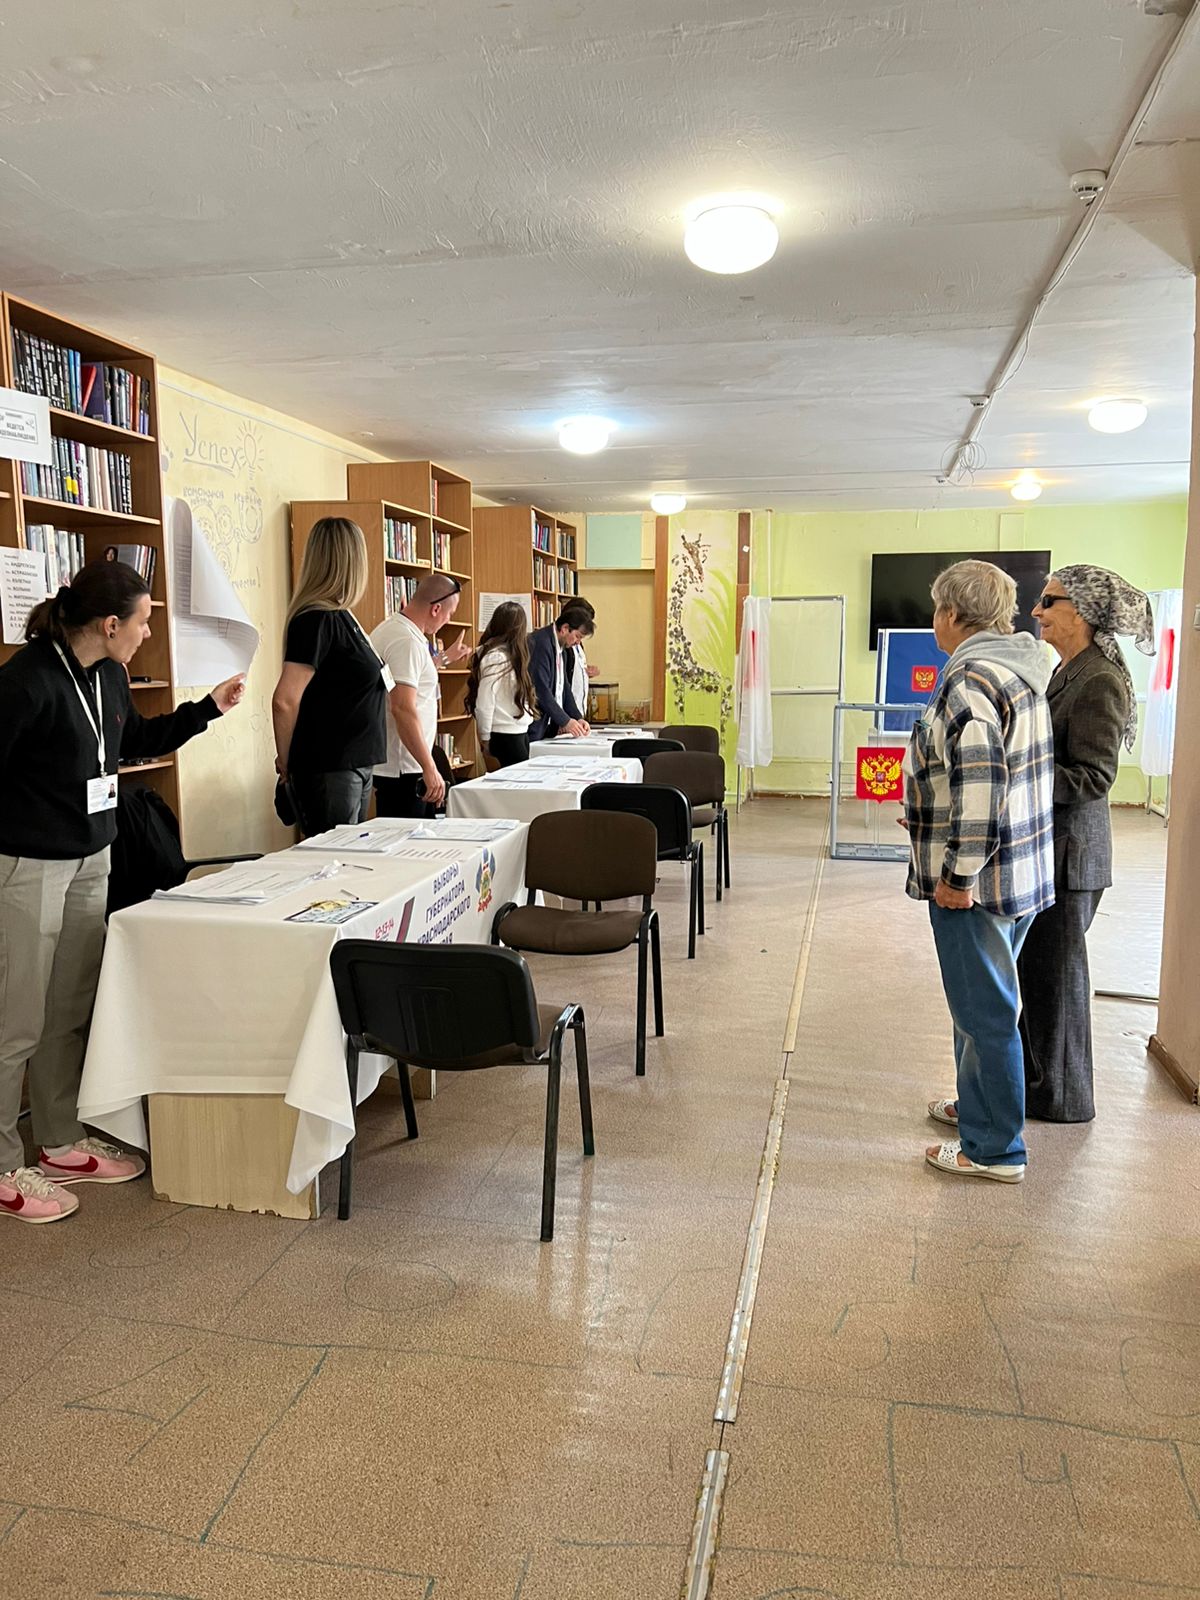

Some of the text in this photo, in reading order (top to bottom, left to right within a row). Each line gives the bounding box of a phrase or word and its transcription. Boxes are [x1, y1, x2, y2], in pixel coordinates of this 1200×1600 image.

[179, 411, 242, 470] Успех
[433, 862, 460, 895] ВЫБОРЫ
[425, 879, 465, 923] ГУБЕРНАТОРА
